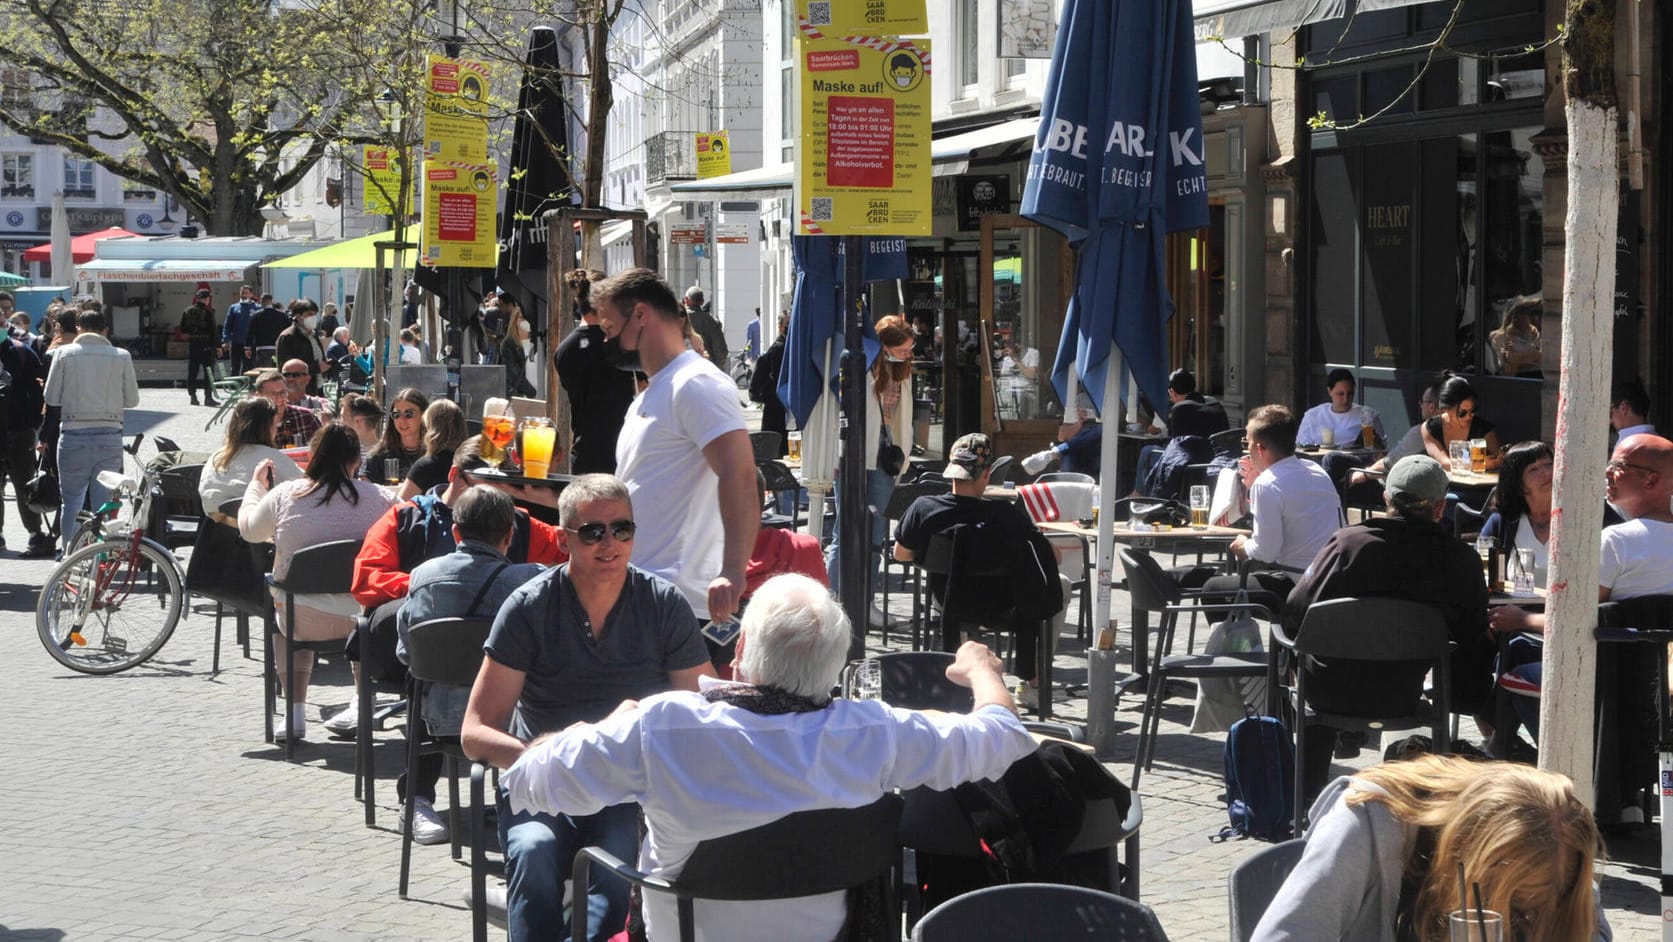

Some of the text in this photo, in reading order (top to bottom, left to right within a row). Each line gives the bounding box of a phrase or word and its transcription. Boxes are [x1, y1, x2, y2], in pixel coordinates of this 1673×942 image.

[813, 80, 884, 93] Maske auf!
[831, 114, 852, 122] Tagen
[1169, 128, 1205, 166] K
[835, 161, 884, 169] Alkoholverbot.
[431, 184, 455, 192] Maske
[1368, 206, 1410, 228] HEART
[870, 239, 906, 254] BEGEIST
